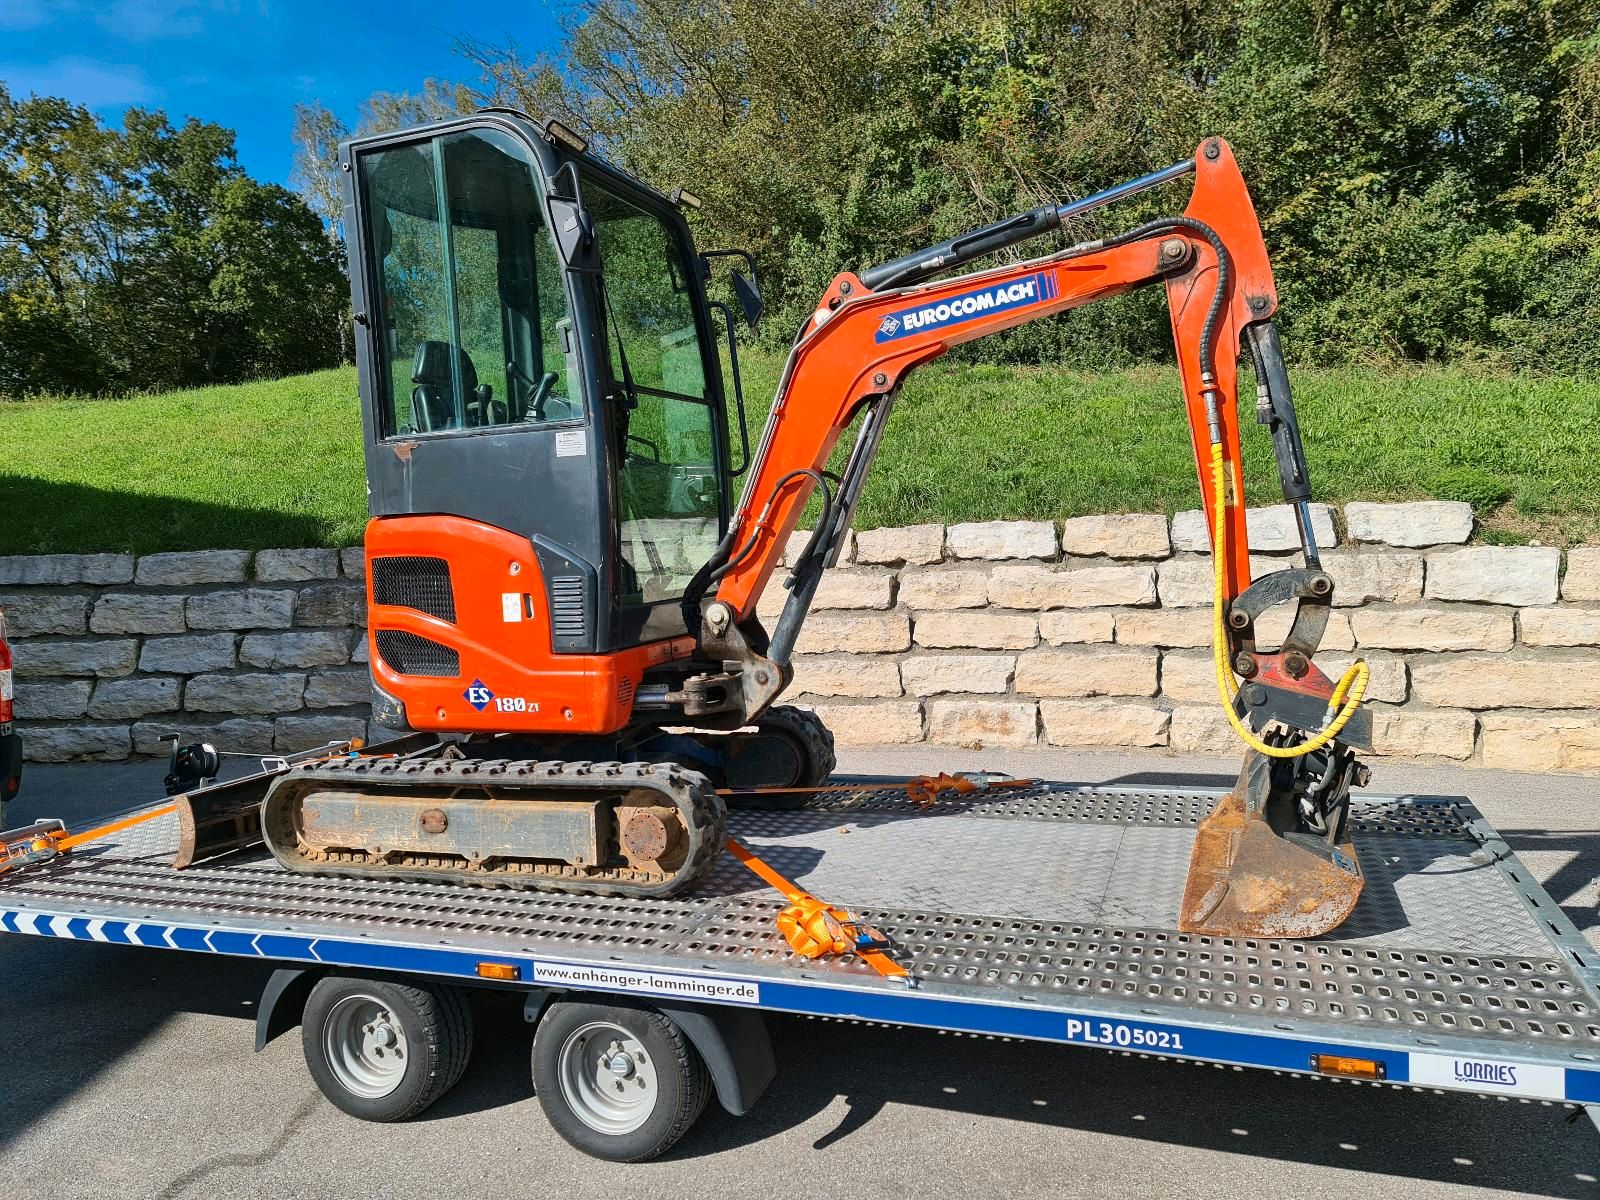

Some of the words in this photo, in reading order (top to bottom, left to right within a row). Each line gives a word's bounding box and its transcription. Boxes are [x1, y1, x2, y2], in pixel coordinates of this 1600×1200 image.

[903, 281, 1036, 331] EUROCOMACH
[468, 687, 490, 703] ES
[535, 966, 755, 998] www.anhänger-lamminger.de
[1454, 1060, 1517, 1086] LORRIES
